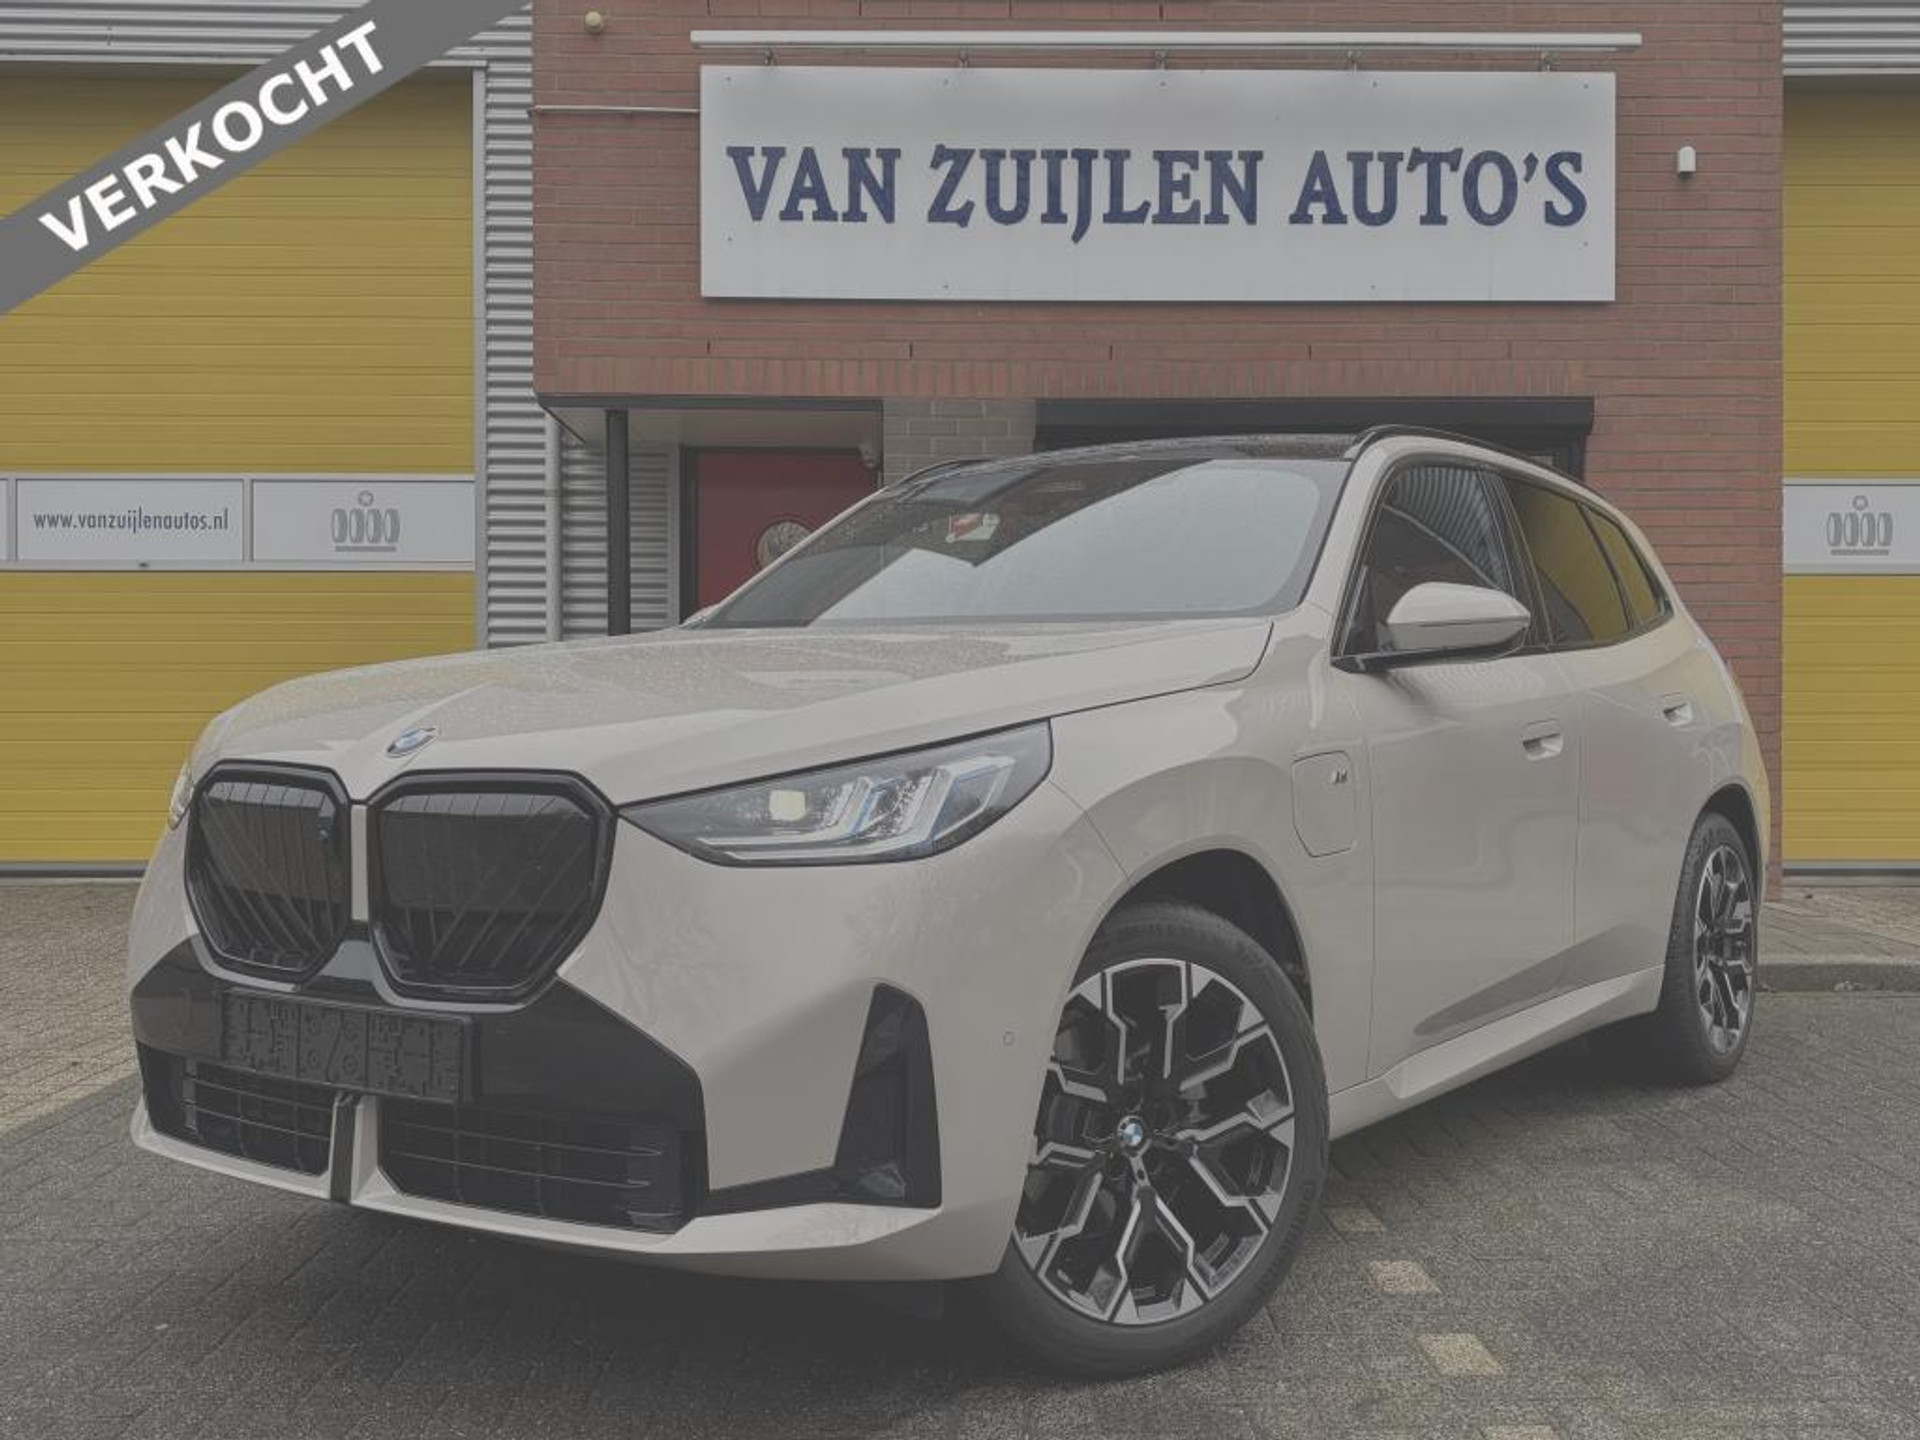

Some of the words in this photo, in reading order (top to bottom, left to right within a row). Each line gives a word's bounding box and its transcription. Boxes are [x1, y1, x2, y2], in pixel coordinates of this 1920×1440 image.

[726, 146, 902, 223] VAN
[927, 143, 1264, 243] ZUIJLEN
[1288, 147, 1587, 227] AUTO'S
[33, 506, 229, 534] www.vanzuijlenautos.nl
